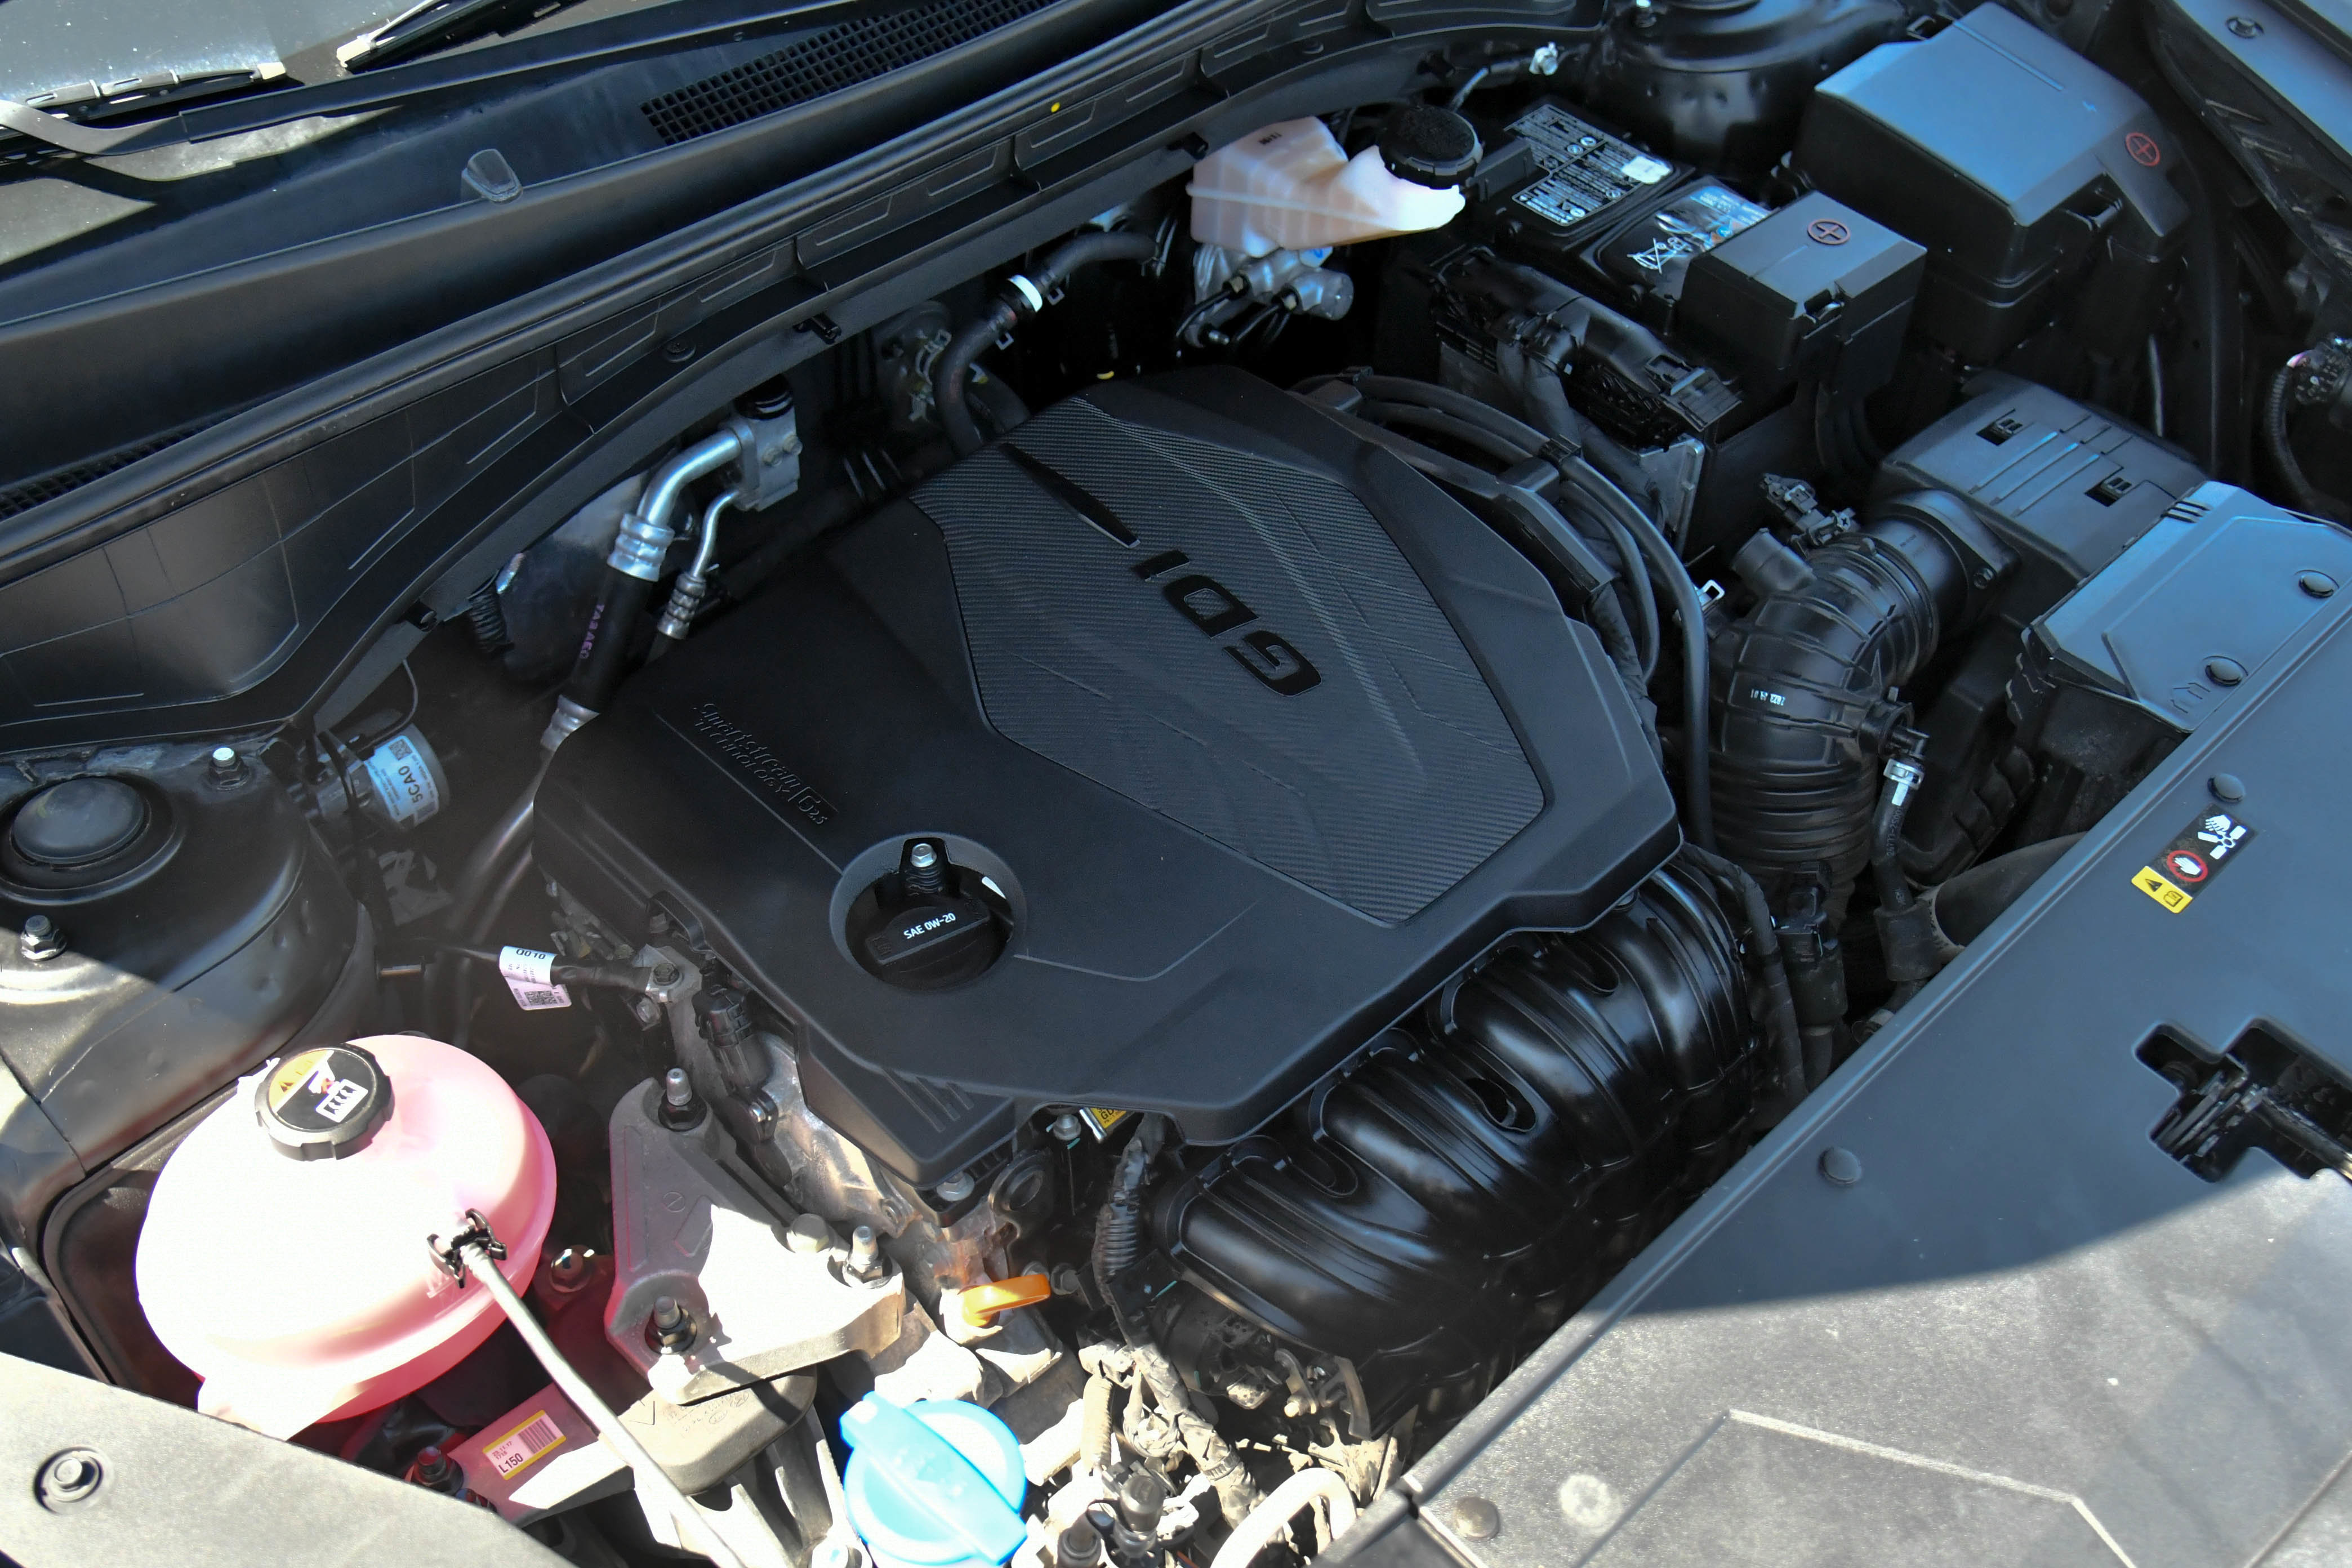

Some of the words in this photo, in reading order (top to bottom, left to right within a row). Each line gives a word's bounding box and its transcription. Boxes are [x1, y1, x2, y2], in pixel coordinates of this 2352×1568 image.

[1130, 550, 1321, 697] GDI
[903, 925, 925, 939] SAE
[924, 912, 956, 931] 0W-20
